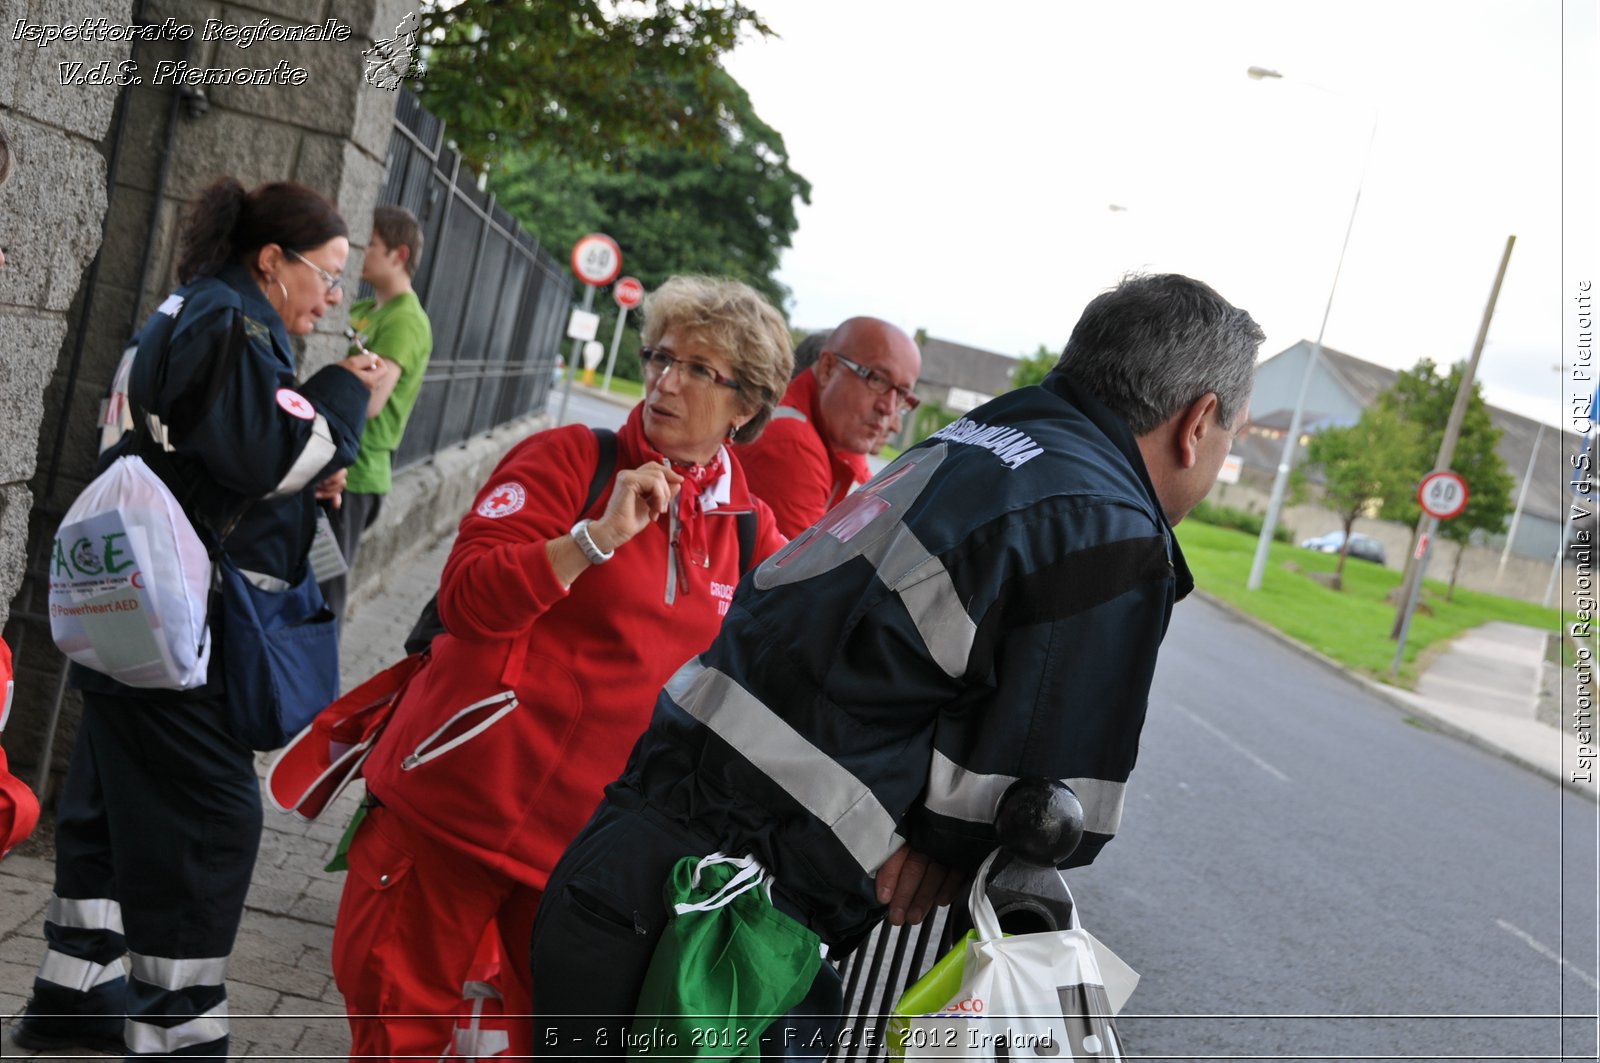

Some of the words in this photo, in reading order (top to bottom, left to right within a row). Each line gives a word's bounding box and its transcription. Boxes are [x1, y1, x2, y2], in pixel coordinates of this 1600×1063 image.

[587, 249, 611, 268] 60
[1430, 480, 1457, 502] 60
[52, 531, 134, 580] ACE
[115, 598, 139, 613] AED
